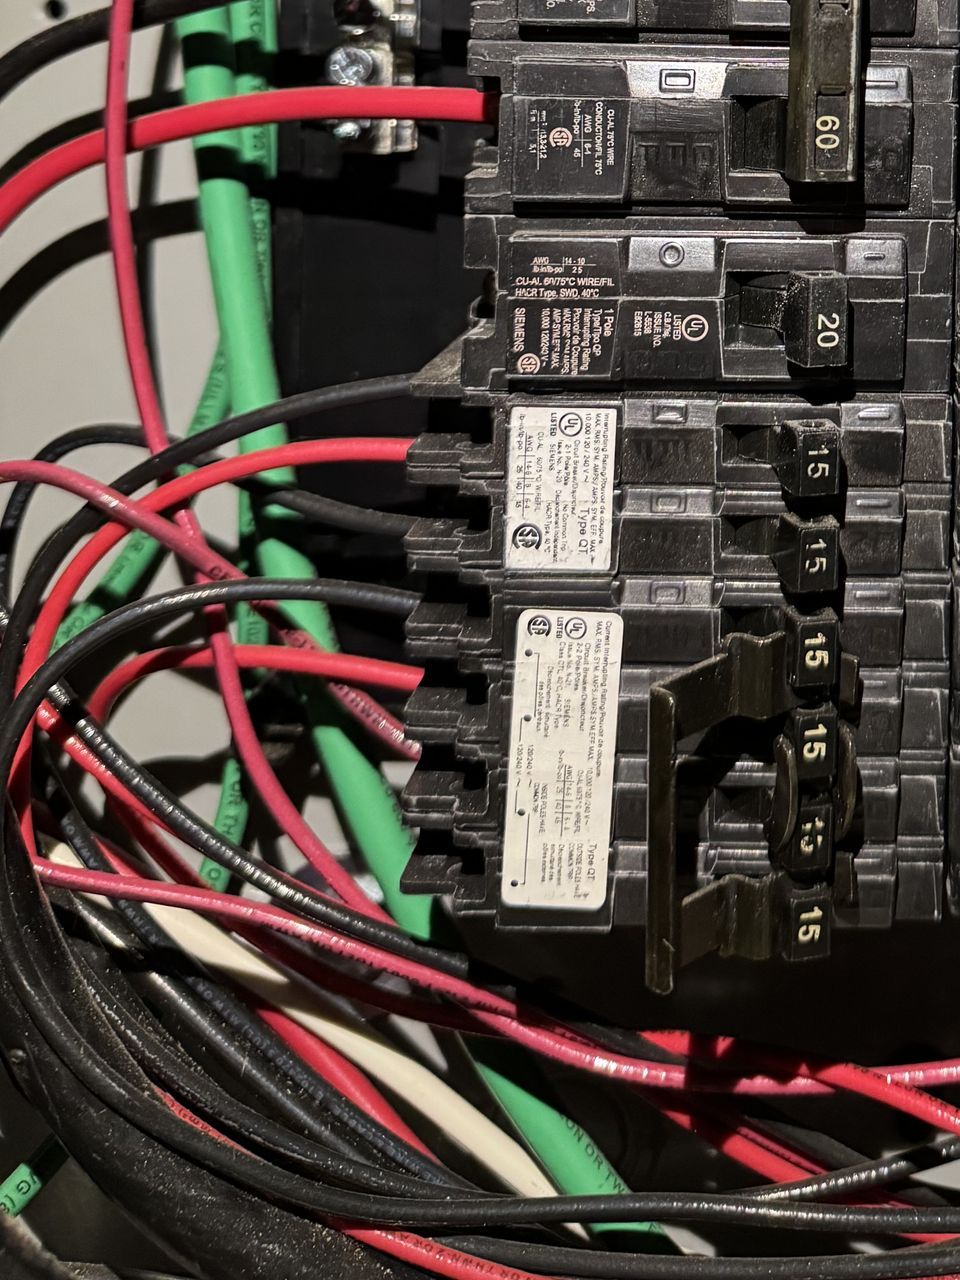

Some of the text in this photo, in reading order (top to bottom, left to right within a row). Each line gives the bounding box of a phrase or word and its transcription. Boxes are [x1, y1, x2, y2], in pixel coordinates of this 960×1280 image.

[815, 114, 840, 150] 60
[513, 307, 526, 352] SIEMENS
[603, 316, 614, 337] Pole
[817, 312, 840, 349] 20
[549, 412, 558, 437] LISTED
[806, 448, 829, 479] 15
[578, 507, 591, 554] Type QT
[804, 539, 827, 575] 15
[803, 632, 828, 670] 15
[802, 723, 828, 761] 15
[586, 842, 597, 881] Type QT
[797, 905, 823, 944] 15
[583, 1142, 604, 1171] OR
